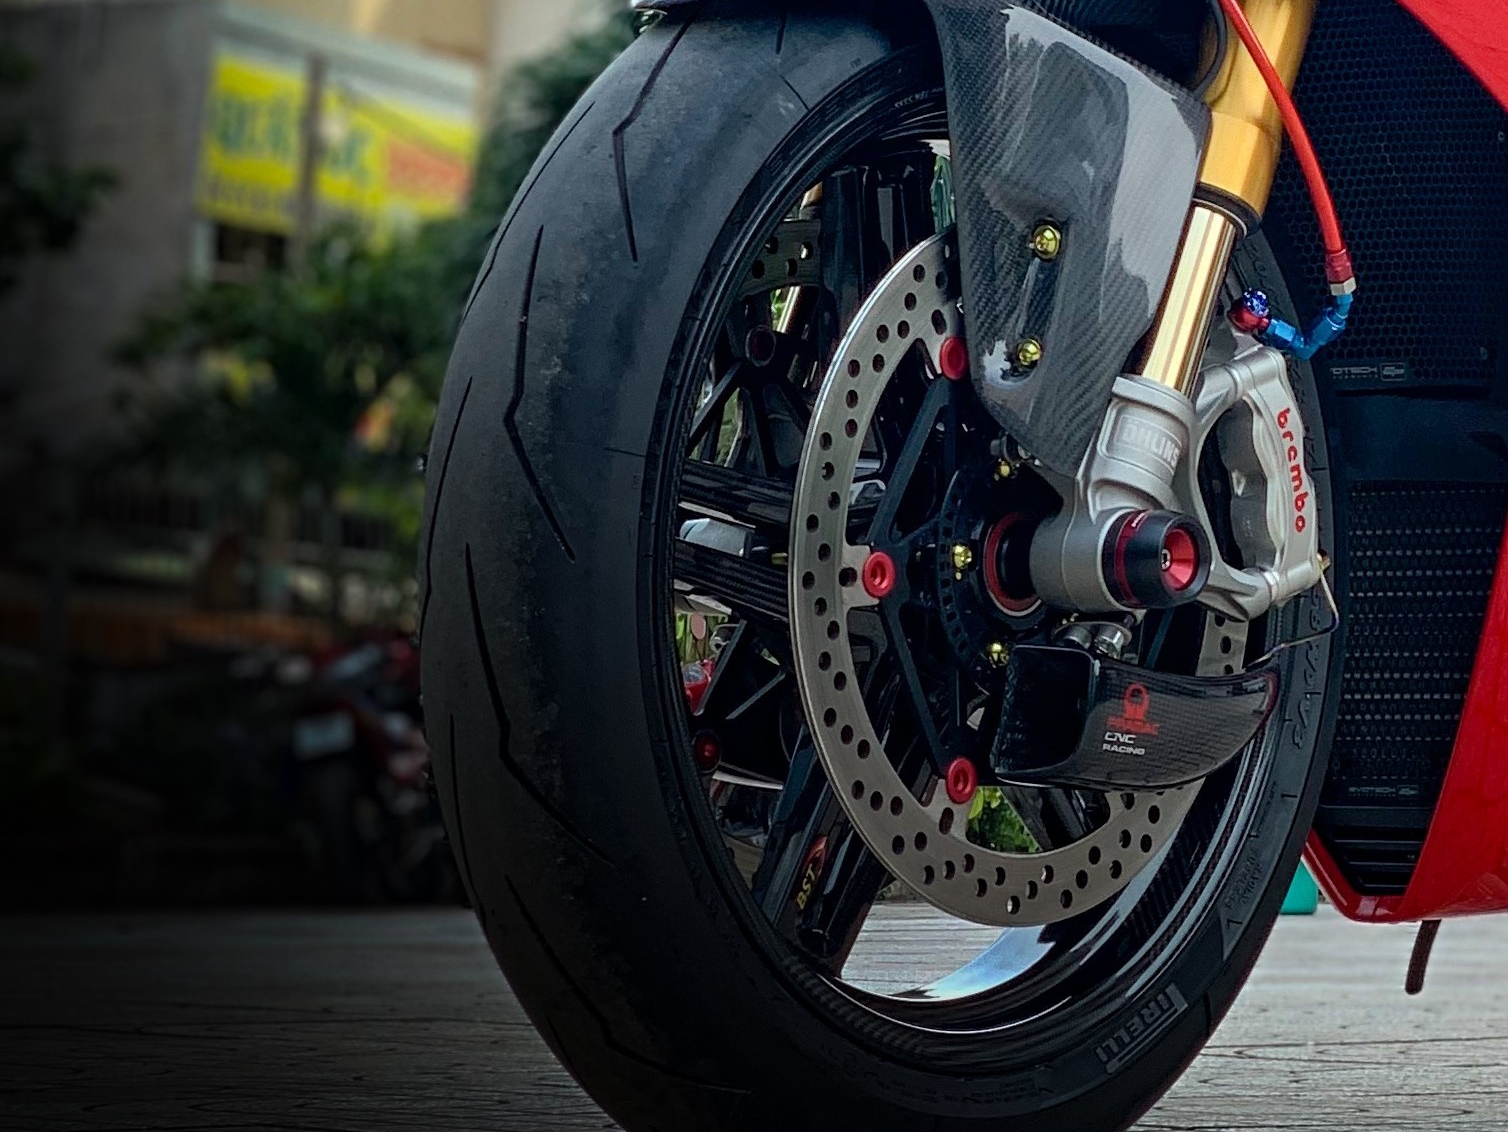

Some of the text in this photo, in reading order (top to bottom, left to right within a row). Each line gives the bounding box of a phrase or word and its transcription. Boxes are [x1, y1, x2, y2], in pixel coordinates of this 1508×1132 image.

[1277, 407, 1309, 533] brembo
[1104, 731, 1137, 744] CNC
[1102, 743, 1146, 756] RACING
